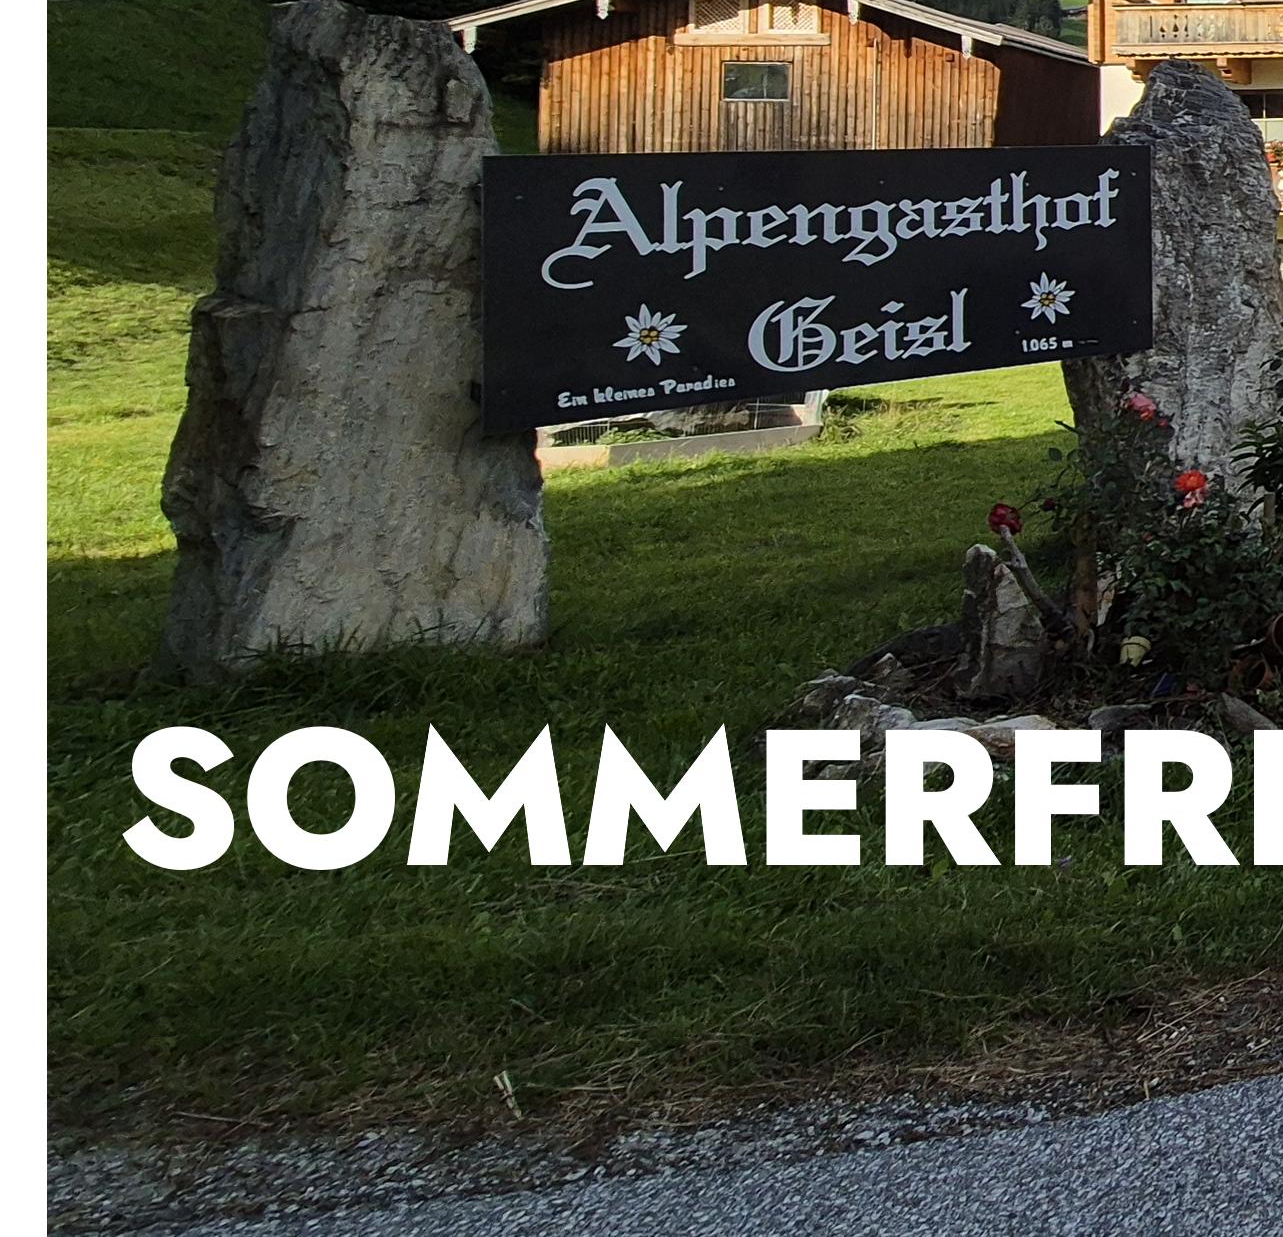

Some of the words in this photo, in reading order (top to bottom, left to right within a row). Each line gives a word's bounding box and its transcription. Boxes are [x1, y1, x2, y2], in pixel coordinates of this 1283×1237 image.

[541, 167, 1120, 290] Alpengasthof
[747, 287, 972, 372] Geisl
[659, 374, 736, 395] Paradies
